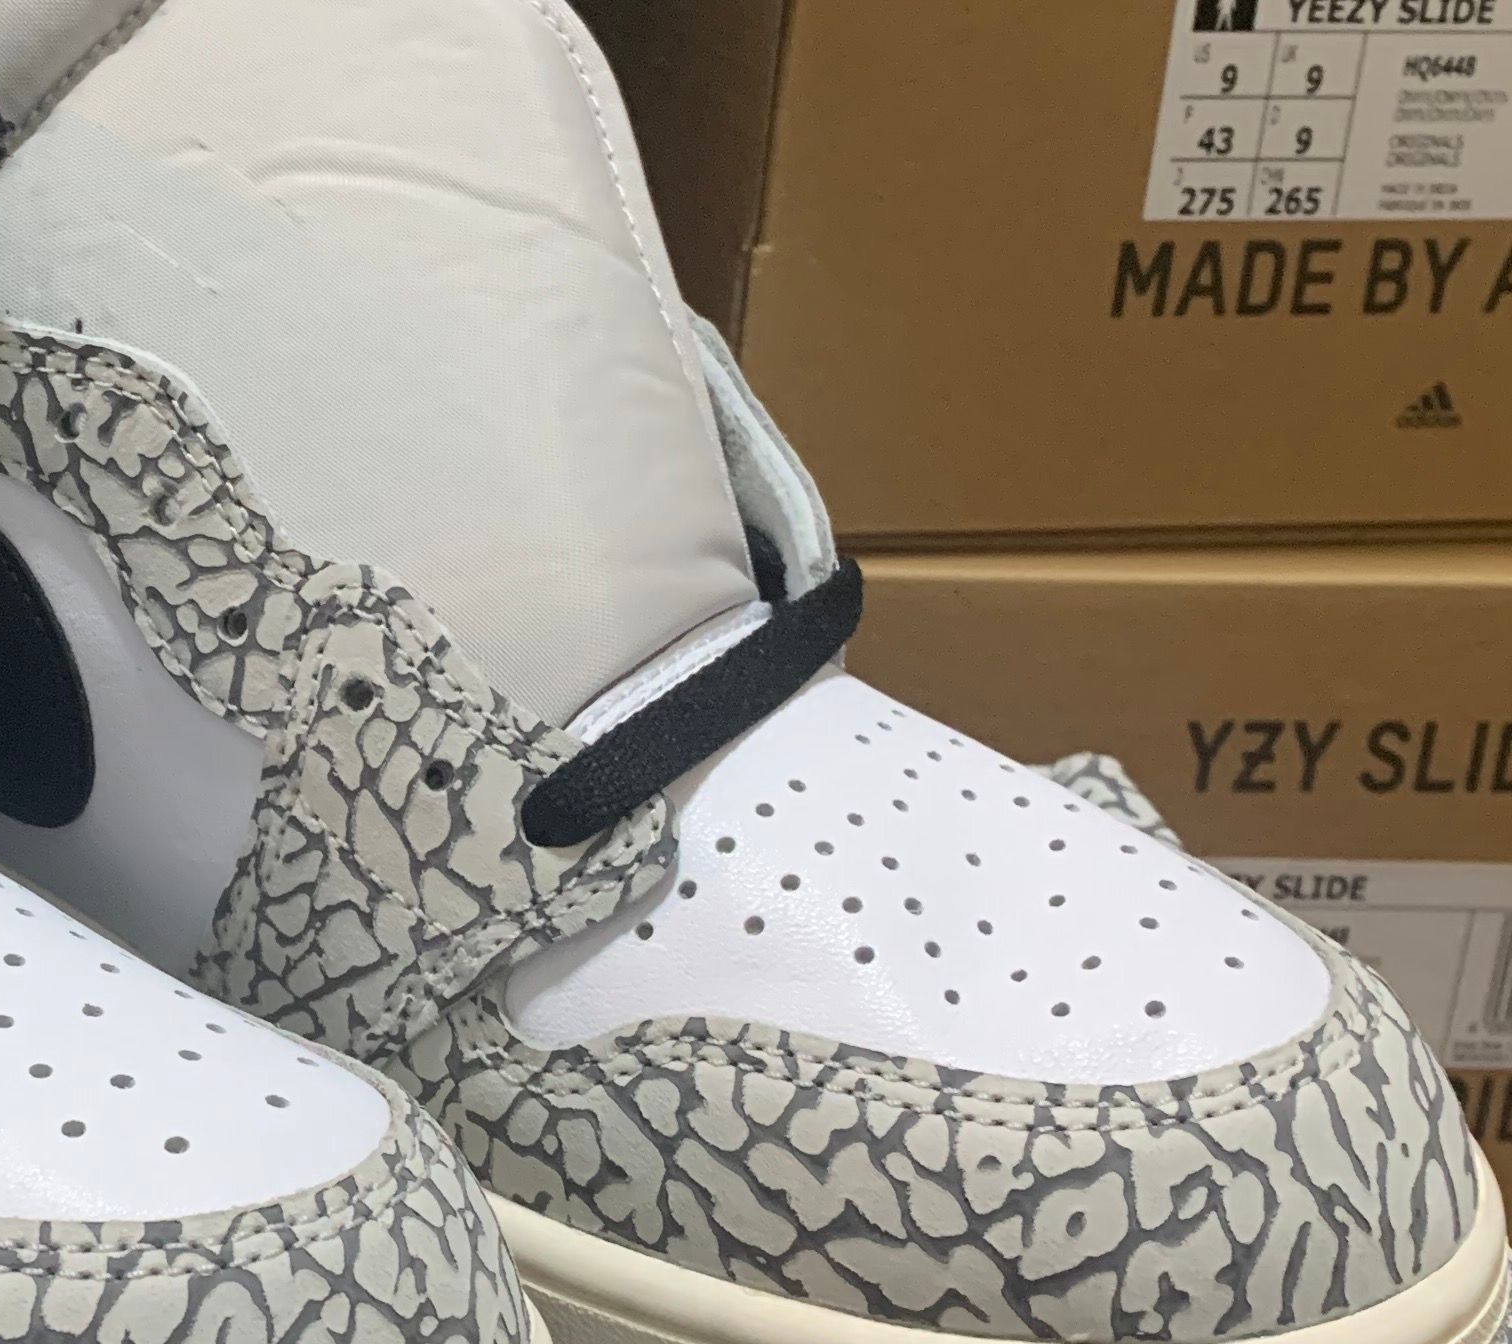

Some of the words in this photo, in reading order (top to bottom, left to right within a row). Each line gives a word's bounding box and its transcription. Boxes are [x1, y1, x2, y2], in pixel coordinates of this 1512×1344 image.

[1220, 64, 1239, 93] 9
[1305, 65, 1324, 93] 9
[1197, 126, 1235, 156] 43
[1294, 126, 1313, 155] 9
[1177, 187, 1236, 216] 275
[1264, 187, 1323, 215] 265
[1110, 239, 1342, 319] MADE
[1362, 238, 1472, 316] BY
[1272, 875, 1368, 901] SLIDE
